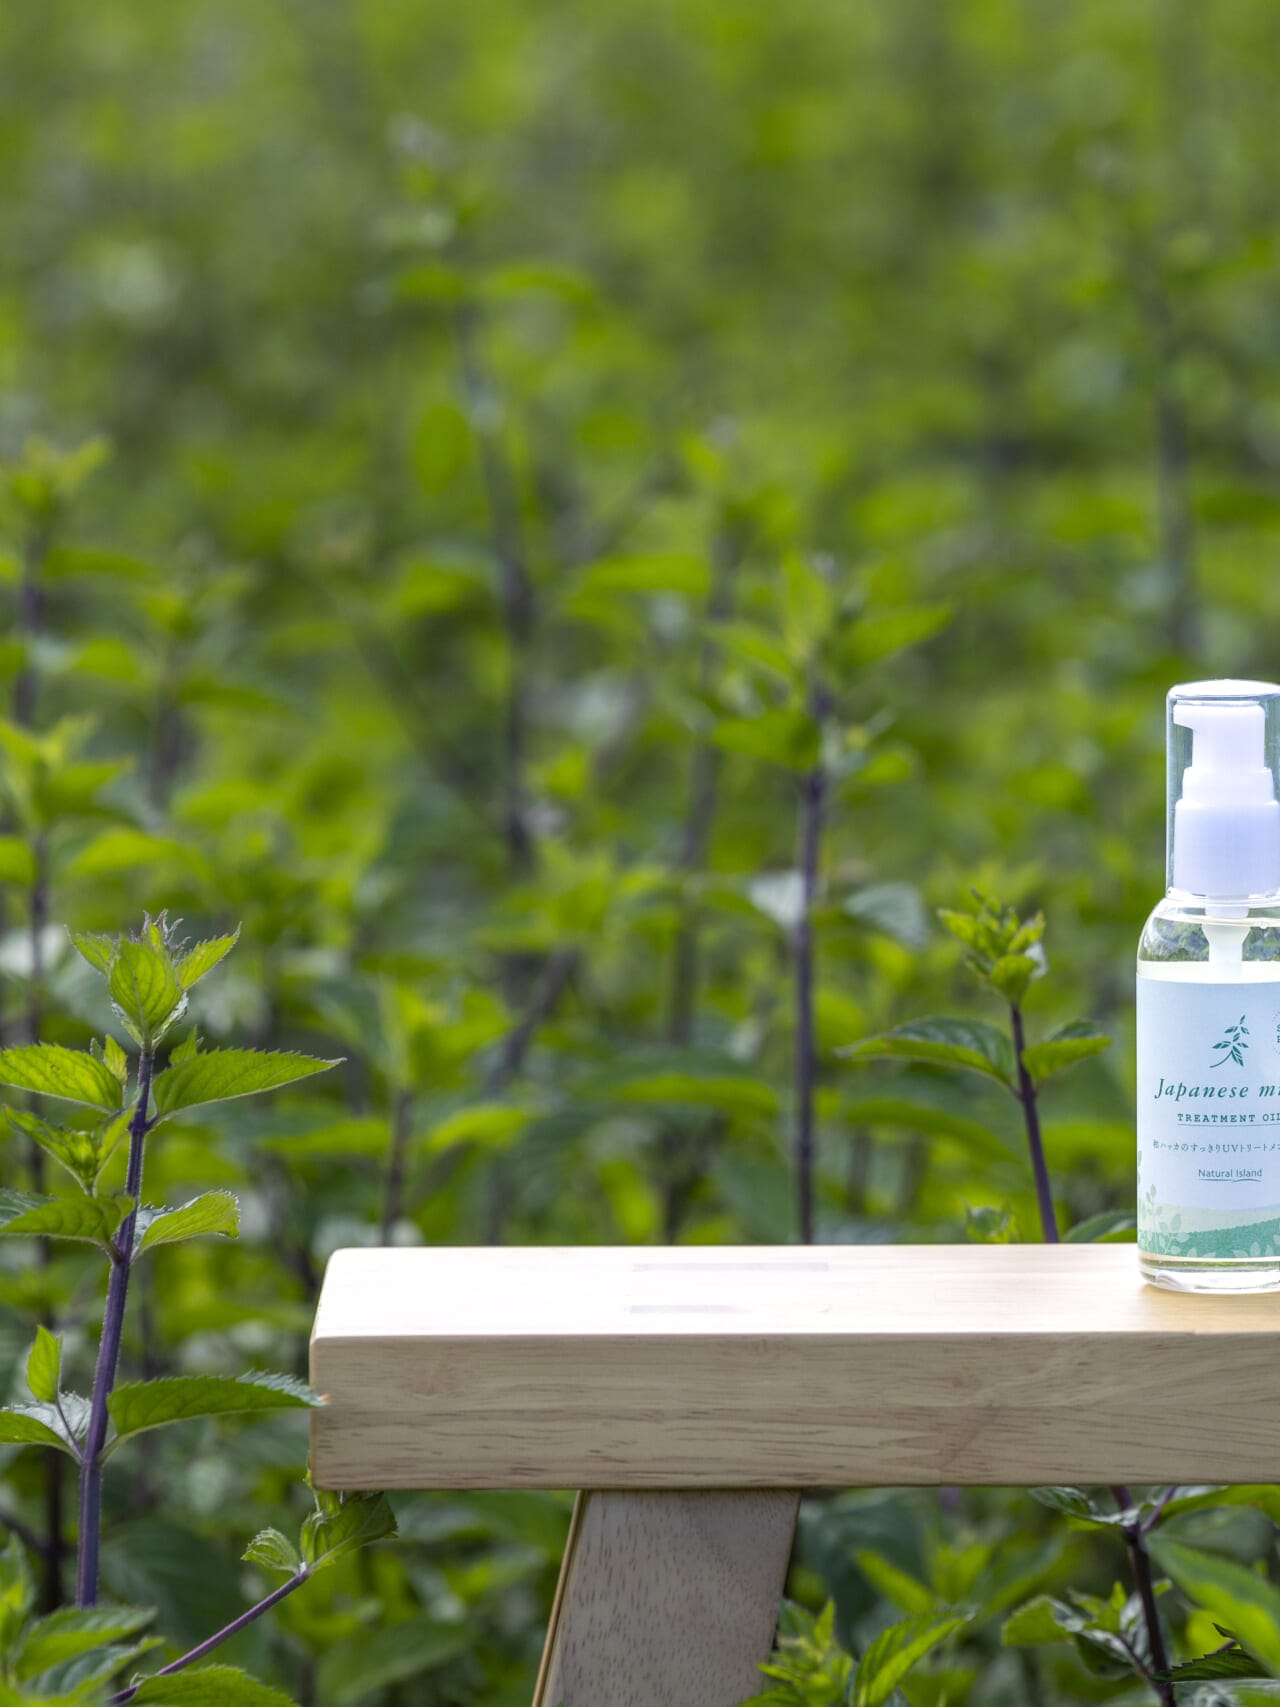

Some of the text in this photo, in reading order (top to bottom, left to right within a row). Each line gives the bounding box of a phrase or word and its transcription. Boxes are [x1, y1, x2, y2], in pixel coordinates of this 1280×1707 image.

[1154, 1078, 1249, 1101] Japanese
[1177, 1113, 1256, 1123] TREATMENT
[1198, 1168, 1263, 1178] Natural Island
